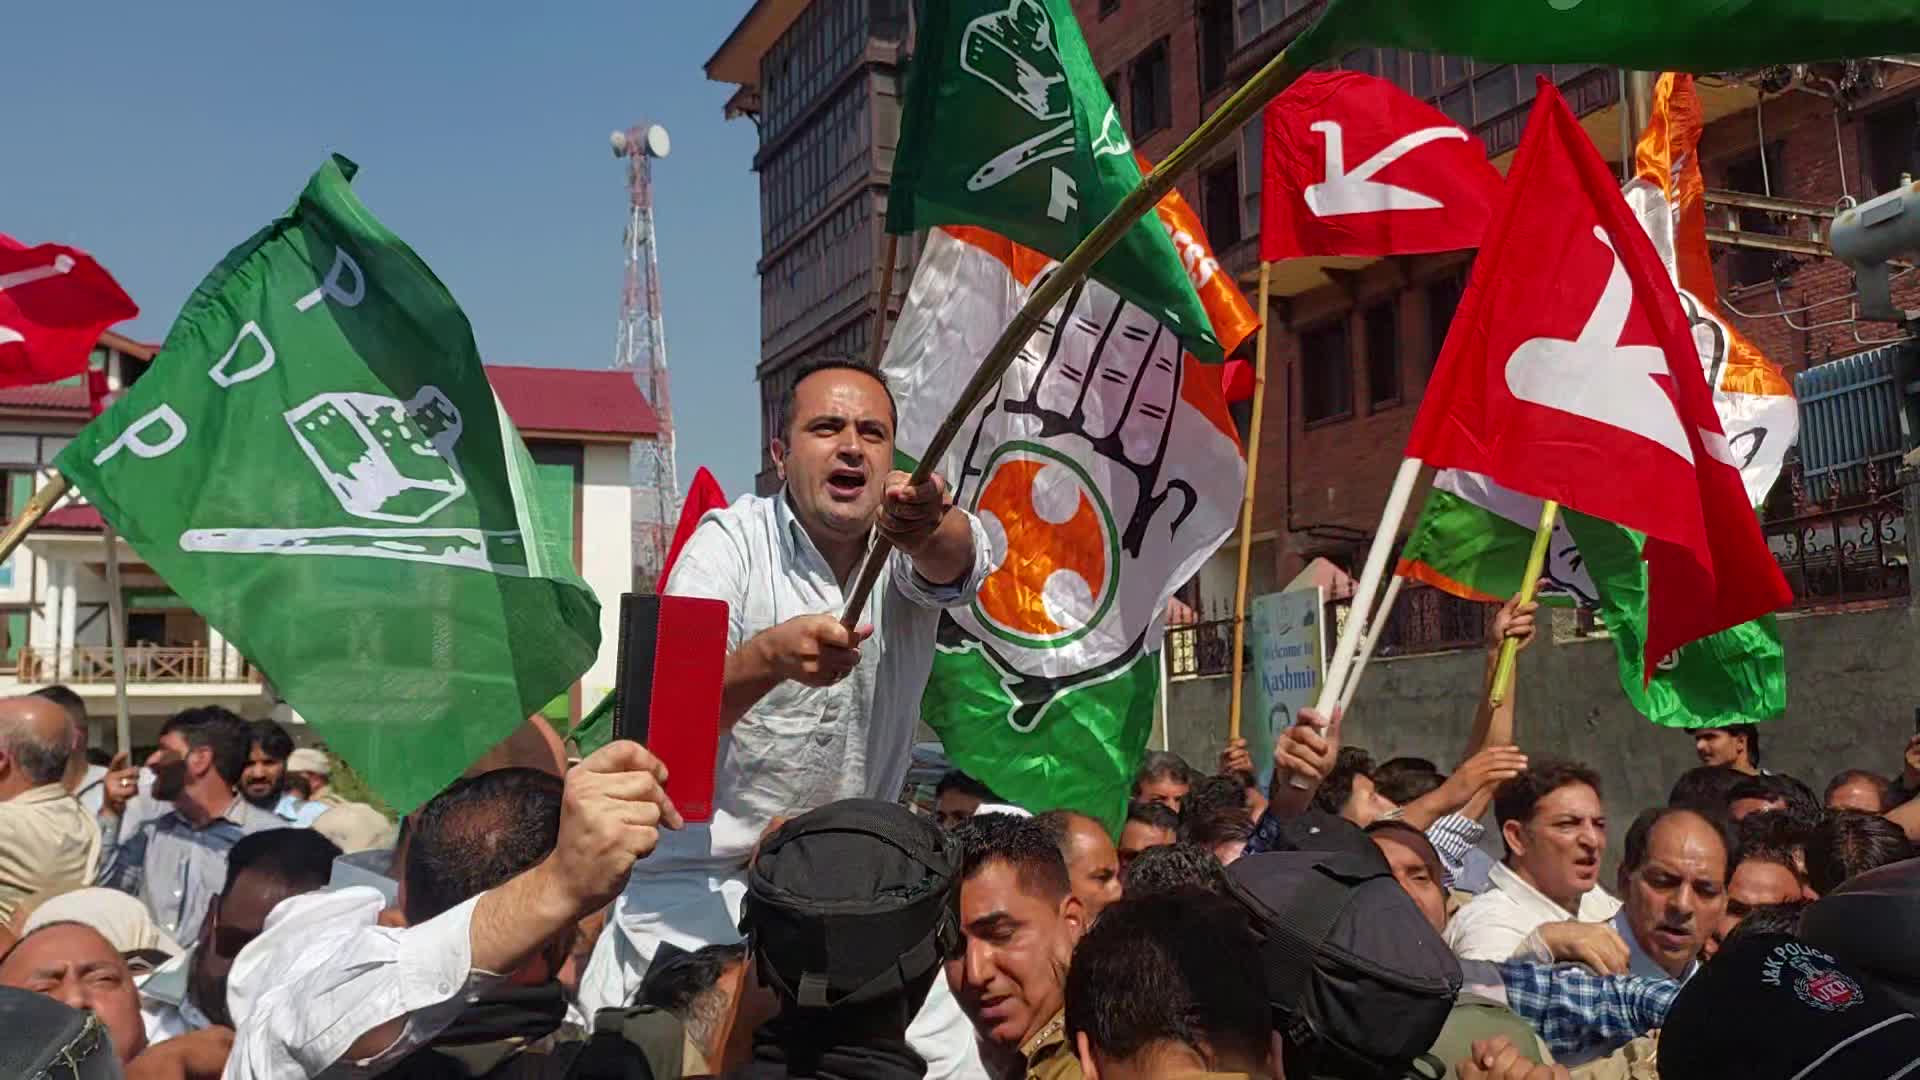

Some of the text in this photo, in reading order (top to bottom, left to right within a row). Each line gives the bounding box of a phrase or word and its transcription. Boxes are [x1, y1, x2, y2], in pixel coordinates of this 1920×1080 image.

[1262, 664, 1316, 696] Kashmir
[1762, 943, 1835, 986] J&K POLICE
